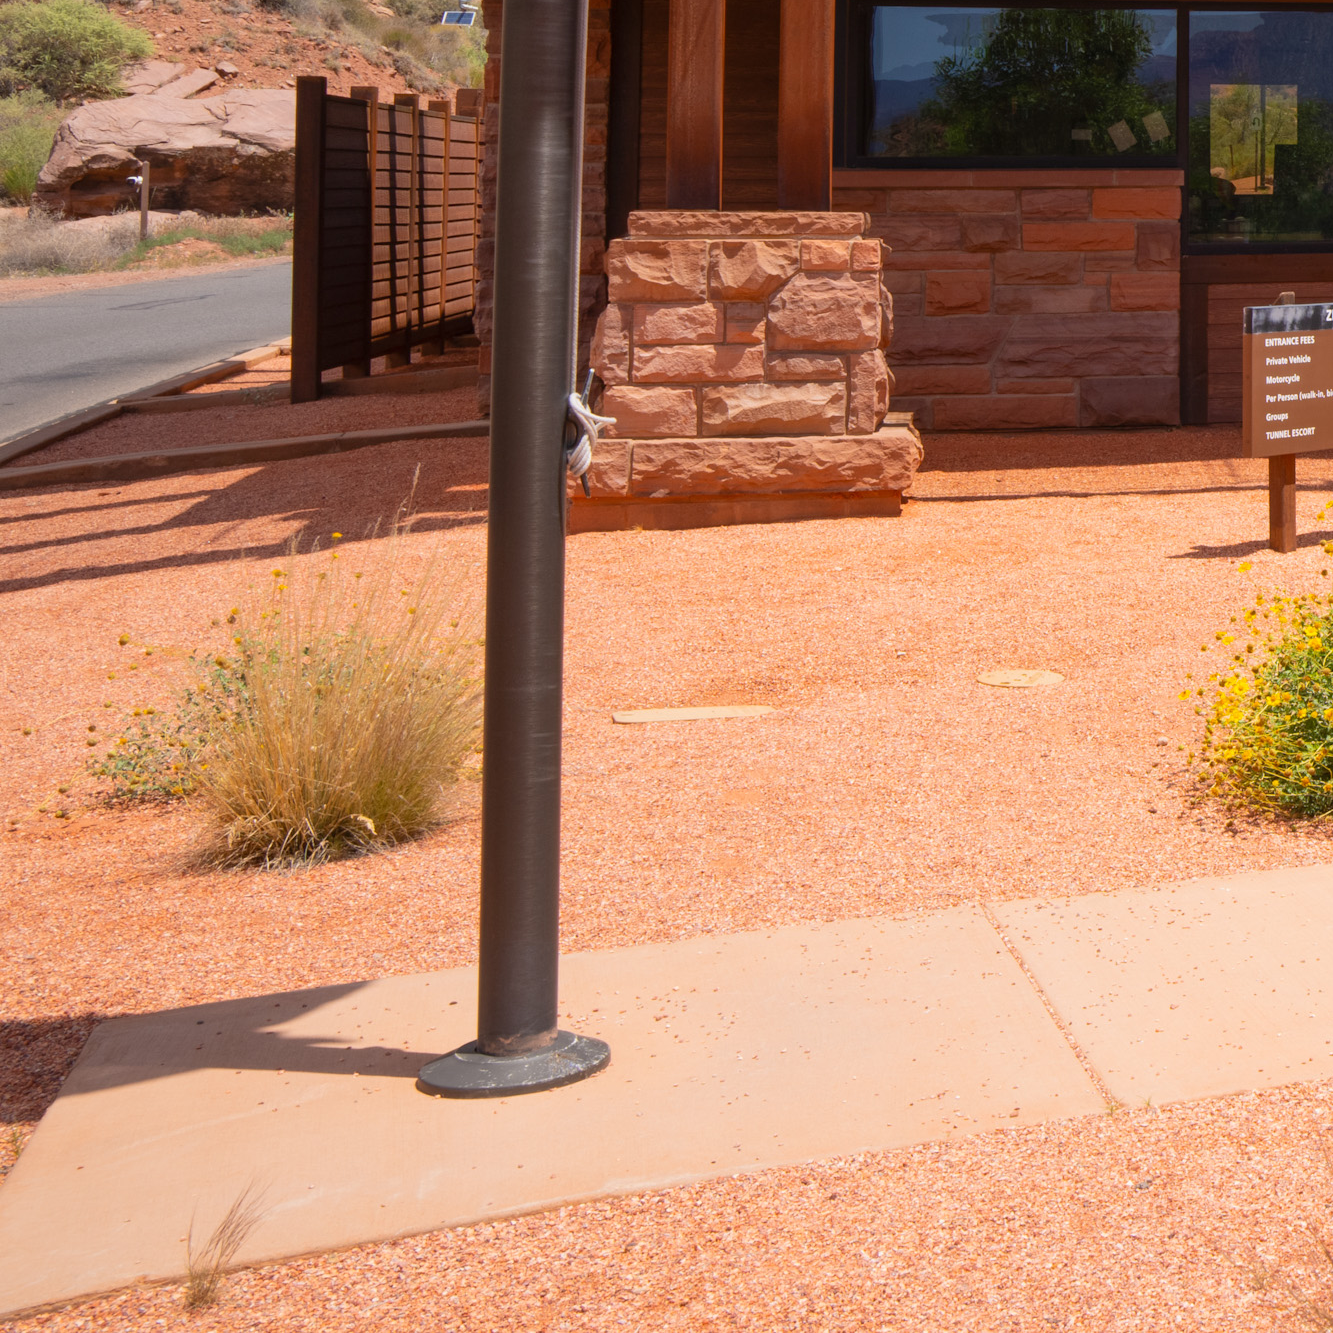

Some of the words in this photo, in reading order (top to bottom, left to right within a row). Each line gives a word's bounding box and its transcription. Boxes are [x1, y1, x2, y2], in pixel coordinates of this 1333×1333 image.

[1265, 337, 1299, 347] ENTRANCE
[1300, 335, 1315, 345] FEES
[1266, 356, 1288, 366] Private
[1289, 354, 1311, 364] Vehicle
[1266, 373, 1300, 384] Motorcycle
[1266, 394, 1276, 403] Per
[1277, 393, 1298, 402] Person
[1299, 389, 1325, 401] (walk-in,
[1266, 412, 1289, 422] Groups
[1266, 431, 1291, 440] TUNNEL
[1291, 427, 1316, 438] ESCORT
